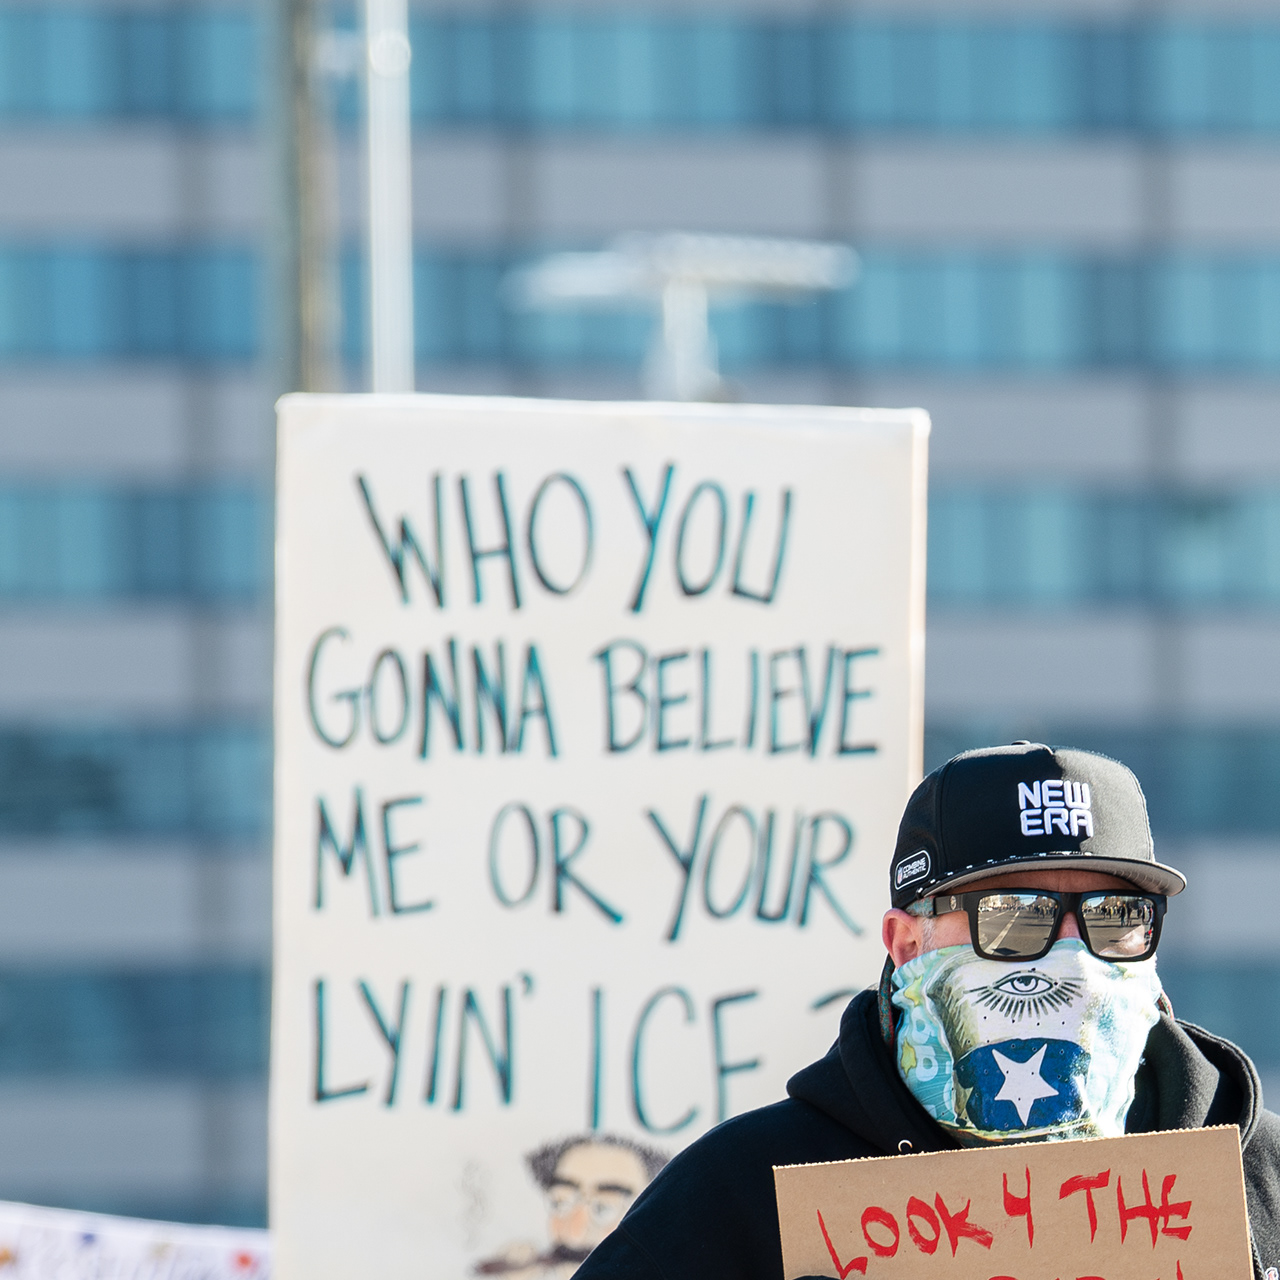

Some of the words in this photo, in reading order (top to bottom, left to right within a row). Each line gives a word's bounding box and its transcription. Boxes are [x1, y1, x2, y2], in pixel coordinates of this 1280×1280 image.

[355, 468, 595, 611] WHO
[620, 463, 794, 614] YOU
[307, 627, 560, 760] GONNA
[592, 638, 881, 760] BELIEVE
[1018, 780, 1091, 810] NEW
[1020, 807, 1094, 838] ERA
[312, 786, 435, 918] ME
[488, 803, 625, 925] OR
[646, 792, 864, 944] YOUR
[312, 972, 534, 1110] LYIN'
[816, 1192, 993, 1280] LOOK
[1002, 1165, 1036, 1248] 4
[1058, 1168, 1193, 1249] THE
